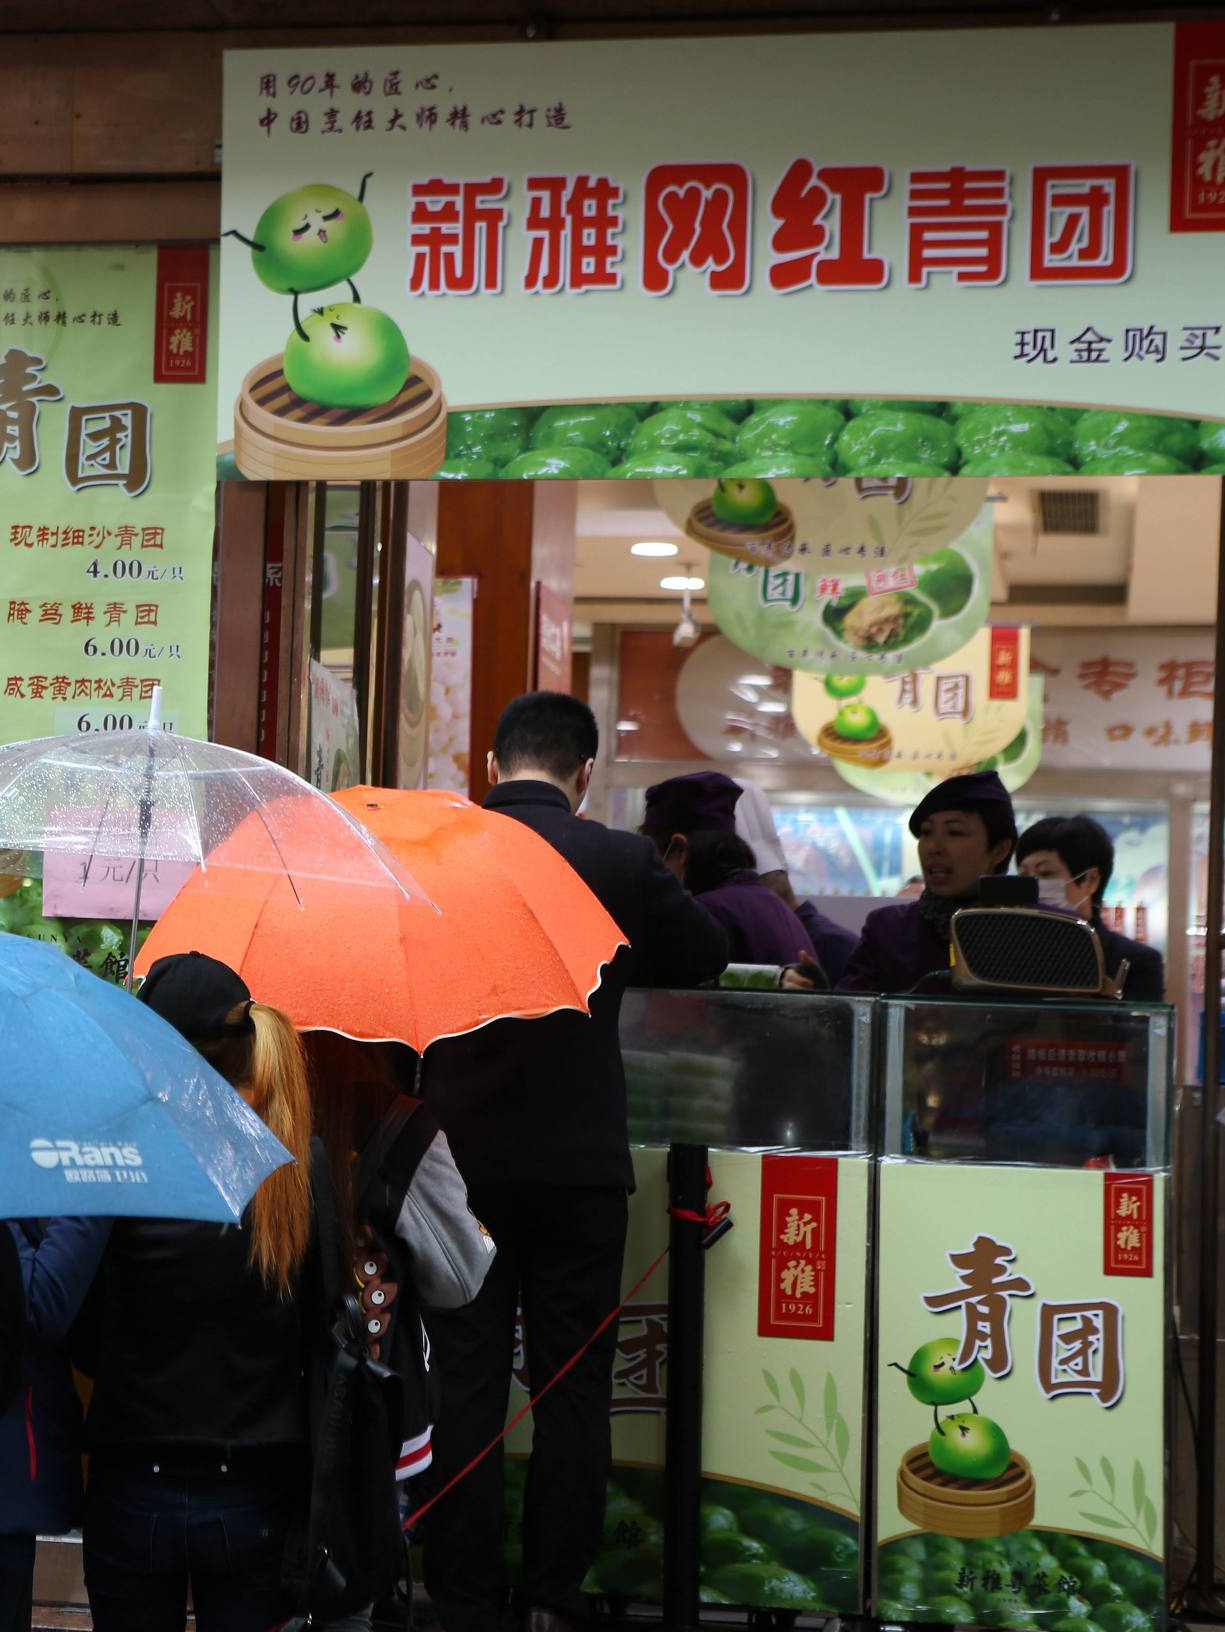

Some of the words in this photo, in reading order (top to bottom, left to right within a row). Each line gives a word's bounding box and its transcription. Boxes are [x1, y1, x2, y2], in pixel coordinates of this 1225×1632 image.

[258, 102, 573, 138] 中国烹饪大师精心打造
[408, 157, 1135, 297] 新雅网红青团
[168, 292, 196, 356] 新雅
[1013, 325, 1225, 364] 现金购买
[169, 359, 192, 368] 1926
[9, 523, 166, 551] 现制细沙青团
[6, 600, 160, 627] 腌笃鲜青团
[3, 675, 161, 702] 咸蛋黄肉松青团
[1116, 1192, 1142, 1251] 新雅
[779, 1207, 817, 1299] 新雅
[779, 1302, 814, 1316] 1926
[921, 1232, 1125, 1409] 青团
